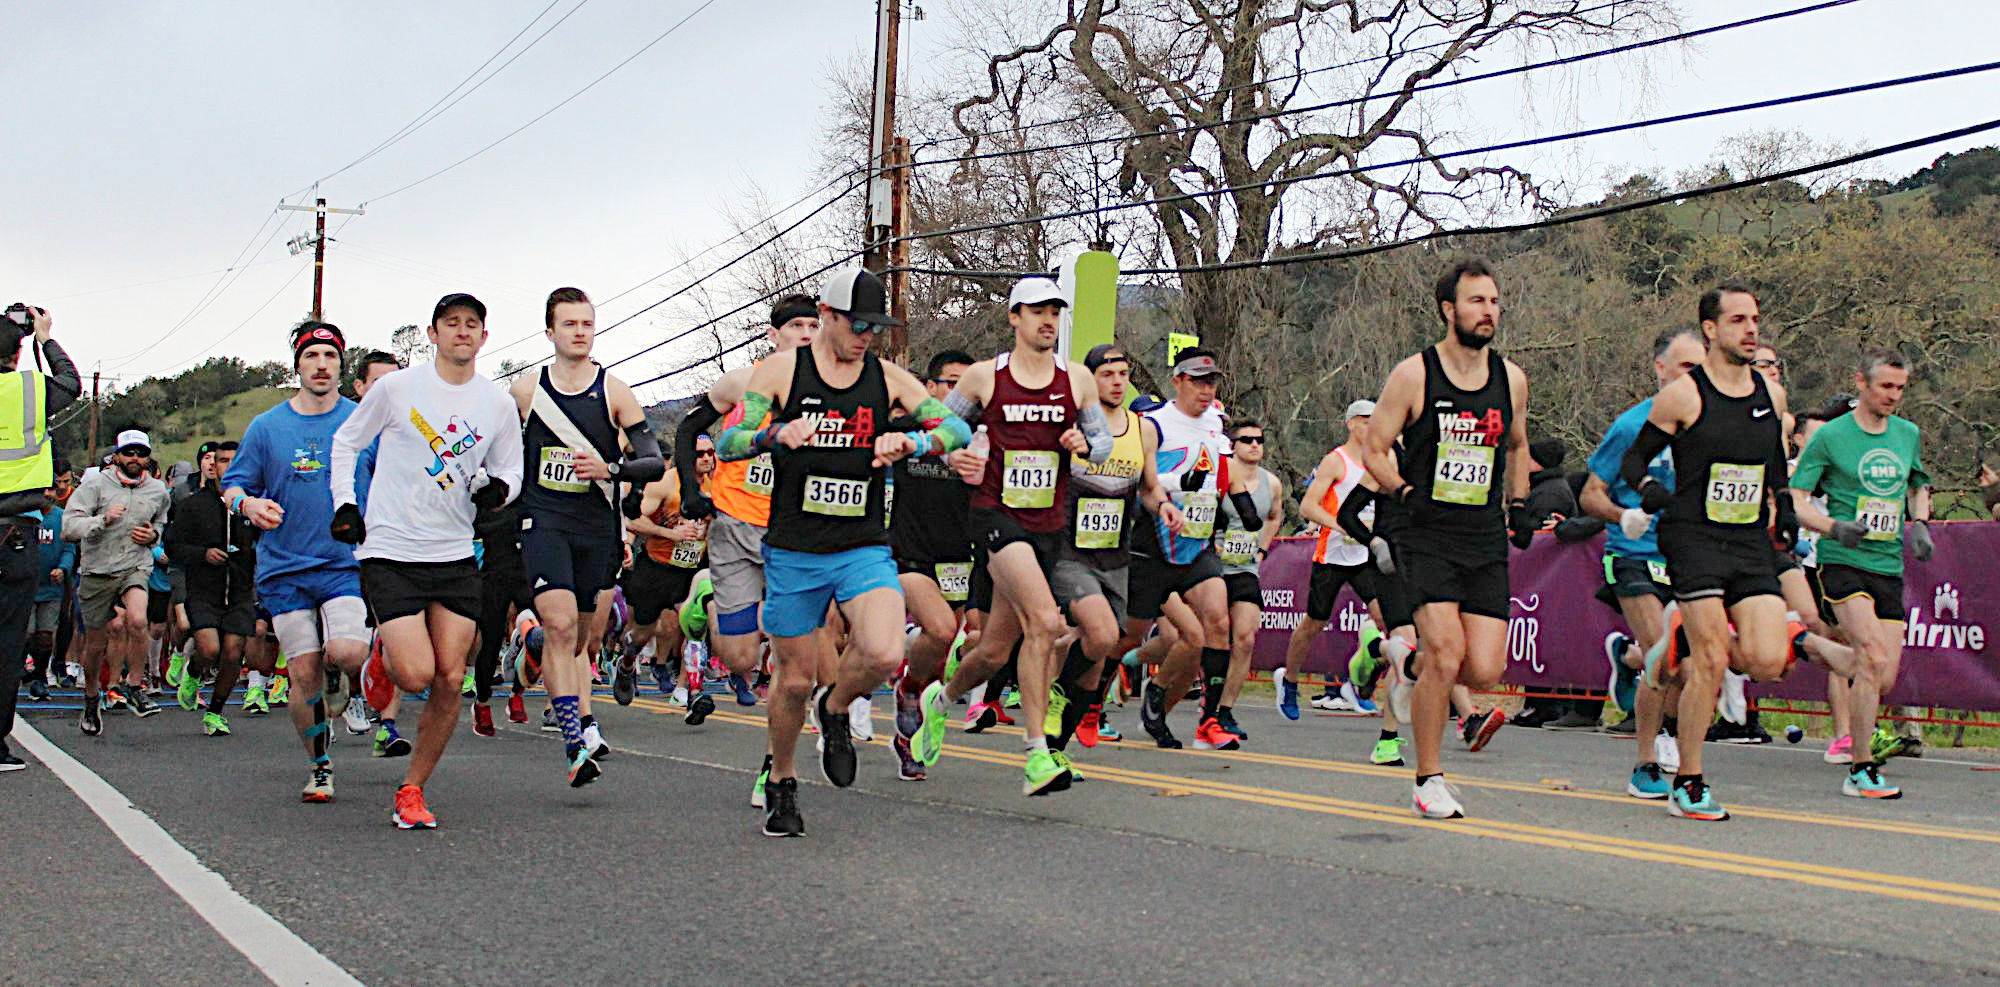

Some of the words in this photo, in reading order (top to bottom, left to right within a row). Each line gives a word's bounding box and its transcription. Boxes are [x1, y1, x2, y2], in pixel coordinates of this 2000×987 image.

[801, 412, 846, 431] WEST
[1002, 405, 1065, 422] WCTC
[1438, 413, 1479, 431] WEST
[804, 434, 854, 447] ALLEY
[543, 462, 588, 482] 407
[1009, 469, 1052, 488] 4031
[1440, 462, 1488, 484] 4238
[810, 480, 863, 505] 3566
[1712, 482, 1758, 502] 5387
[1081, 514, 1120, 531] 4939
[1226, 541, 1253, 554] 3921
[1340, 601, 1369, 632] thr
